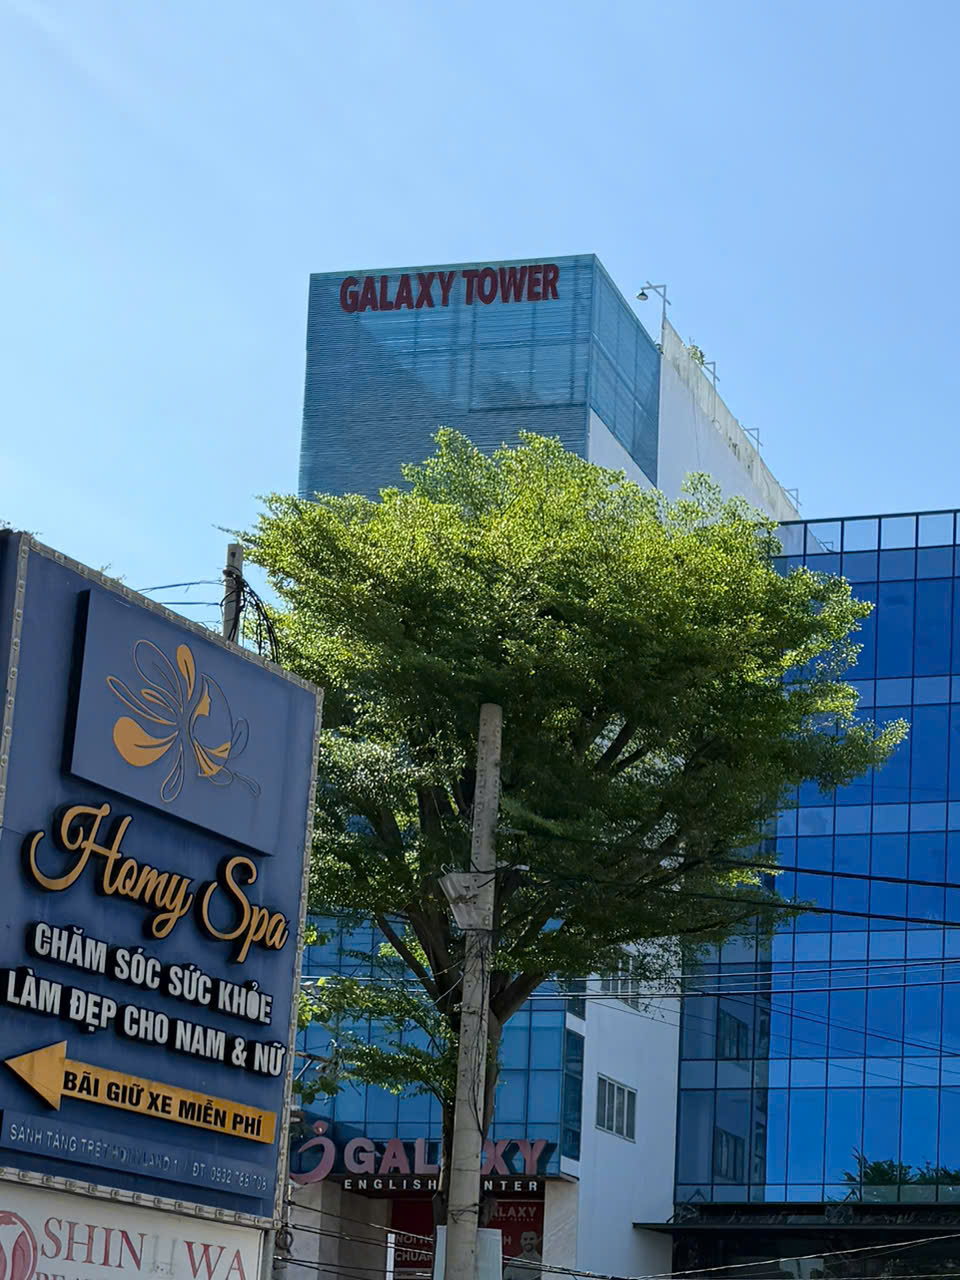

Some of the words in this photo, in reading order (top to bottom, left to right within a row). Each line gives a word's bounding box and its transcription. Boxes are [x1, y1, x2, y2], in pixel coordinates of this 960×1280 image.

[339, 270, 456, 313] GALAXY
[462, 264, 560, 305] TOWER
[29, 803, 195, 939] Homy
[202, 856, 290, 963] Spa
[34, 922, 108, 974] CHĂM
[114, 948, 161, 990] SÓC
[168, 964, 212, 1005] SỨC
[7, 967, 62, 1015] LÀM
[70, 987, 117, 1032] ĐẸP
[123, 1004, 169, 1044] CHO
[175, 1020, 227, 1061] NAM
[231, 1037, 247, 1068] &
[254, 1042, 287, 1077] NỮ
[63, 1070, 99, 1098] BÃI
[106, 1082, 144, 1107] GIỮ
[147, 1091, 172, 1115] XE
[178, 1098, 227, 1128] MIỄN
[232, 1110, 262, 1137] PHÍ
[344, 1137, 548, 1175] GALXY
[344, 1179, 437, 1190] ENGLISH
[41, 1217, 147, 1271] SHIN
